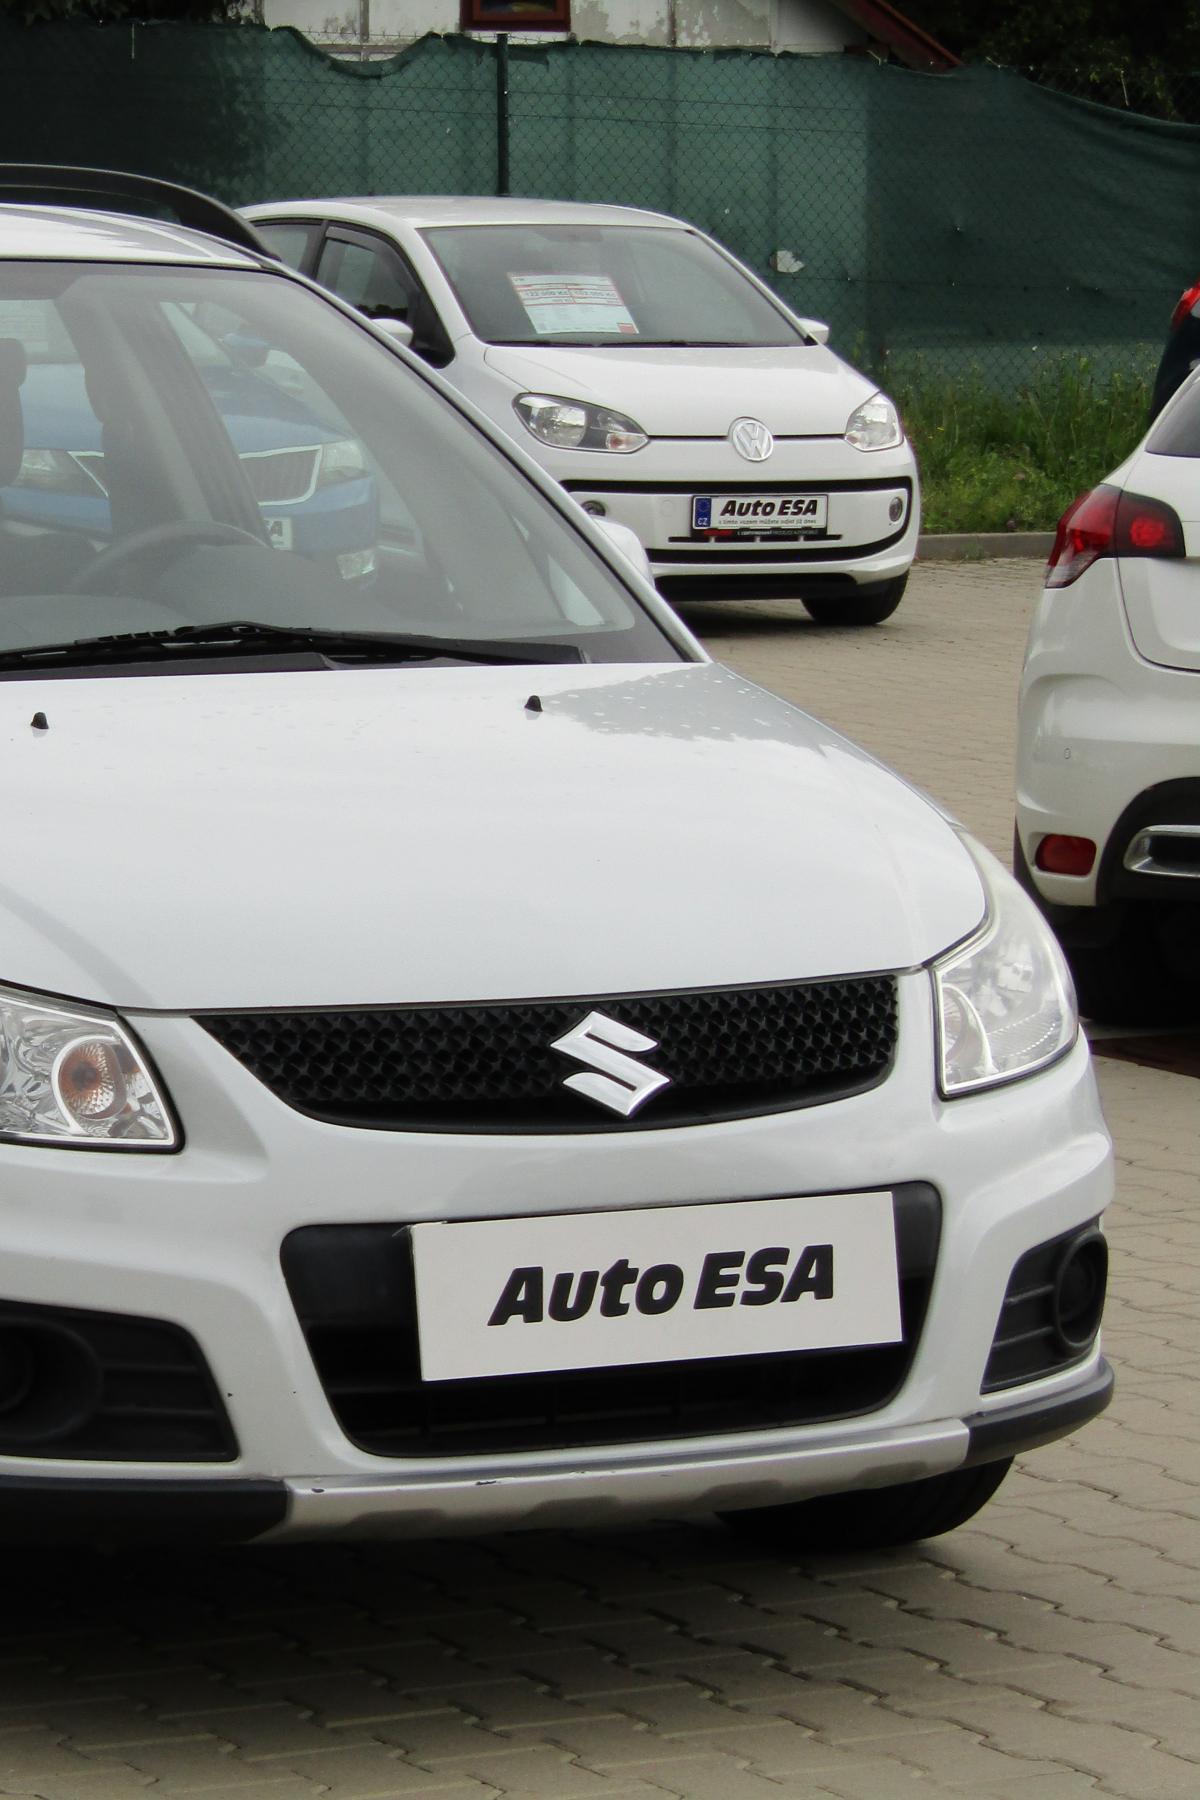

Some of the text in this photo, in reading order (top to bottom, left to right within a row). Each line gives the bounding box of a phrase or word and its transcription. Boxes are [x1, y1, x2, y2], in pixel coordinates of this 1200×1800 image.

[719, 499, 818, 517] Auto ESA
[487, 1244, 834, 1327] Auto ESA
